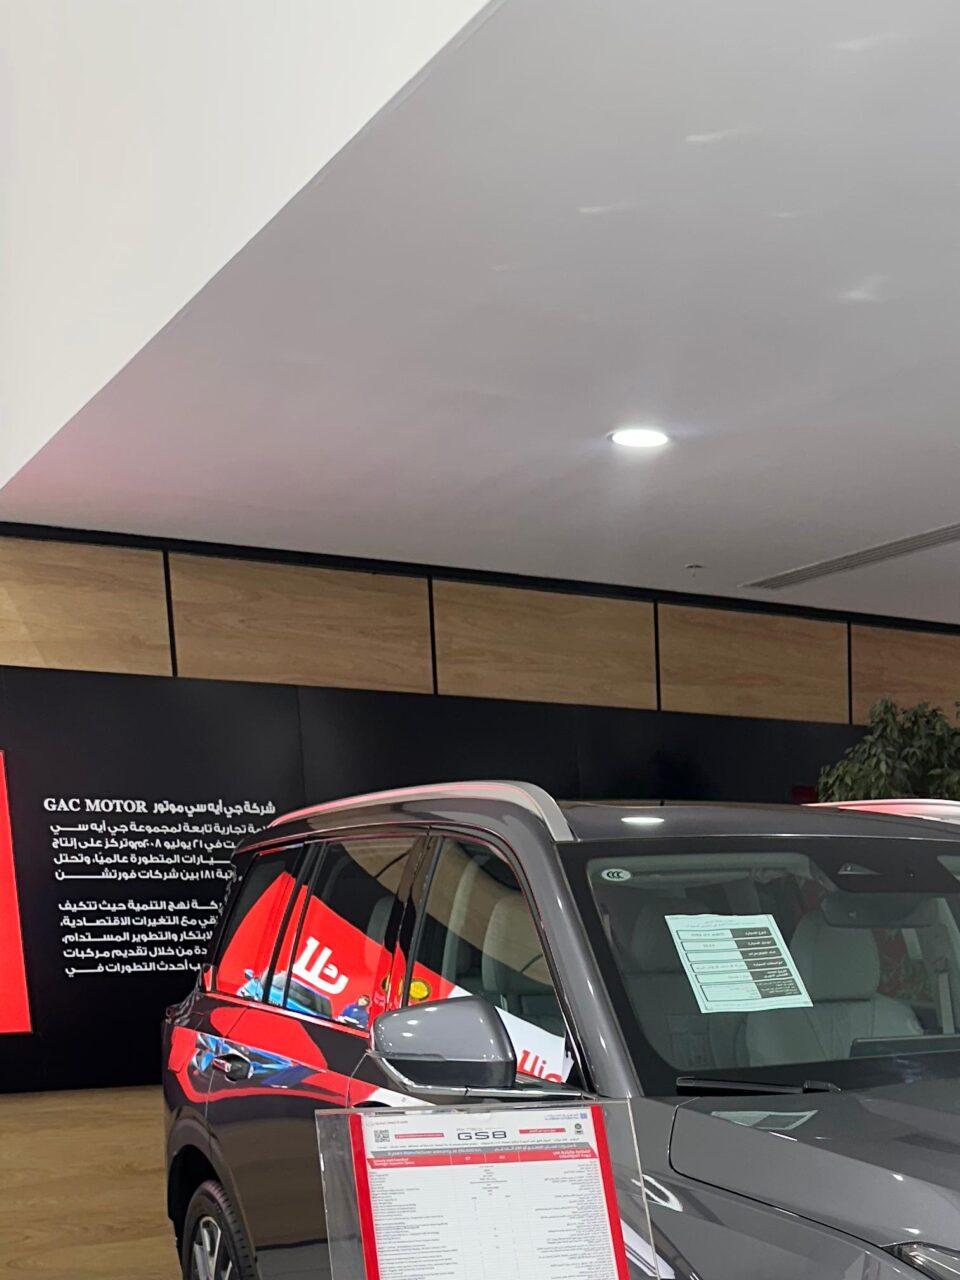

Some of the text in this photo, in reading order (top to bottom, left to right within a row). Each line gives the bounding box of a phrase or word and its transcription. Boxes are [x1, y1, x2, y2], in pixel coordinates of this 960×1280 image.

[43, 798, 81, 812] GAC
[84, 798, 148, 813] MOTOR
[153, 800, 184, 814] موتور
[185, 802, 207, 817] سي
[223, 804, 243, 818] جي
[243, 801, 276, 816] شركة
[107, 823, 129, 836] جي
[129, 821, 182, 834] لمجموعة
[182, 822, 212, 834] تابعة
[213, 823, 247, 835] تجارية
[51, 837, 77, 850] إنتاج
[78, 838, 103, 849] على
[164, 839, 192, 850] يوليو
[204, 840, 221, 852] في
[53, 853, 91, 865] وتحتل
[130, 854, 181, 865] المتطورة
[181, 854, 231, 866] يارات
[137, 867, 179, 881] شركات
[180, 868, 200, 881] بين
[58, 900, 98, 913] تتكيف
[98, 900, 127, 912] حيث
[127, 899, 166, 912] التنمية
[168, 901, 190, 912] نهج
[132, 916, 179, 927] التغيرات
[180, 916, 197, 927] مع
[131, 931, 178, 942] والتطوير
[63, 948, 111, 959] مركبات
[111, 946, 147, 959] تقديم
[148, 946, 175, 958] خلال
[175, 946, 193, 957] من
[105, 961, 156, 974] التطورات
[157, 958, 188, 971] أحدث
